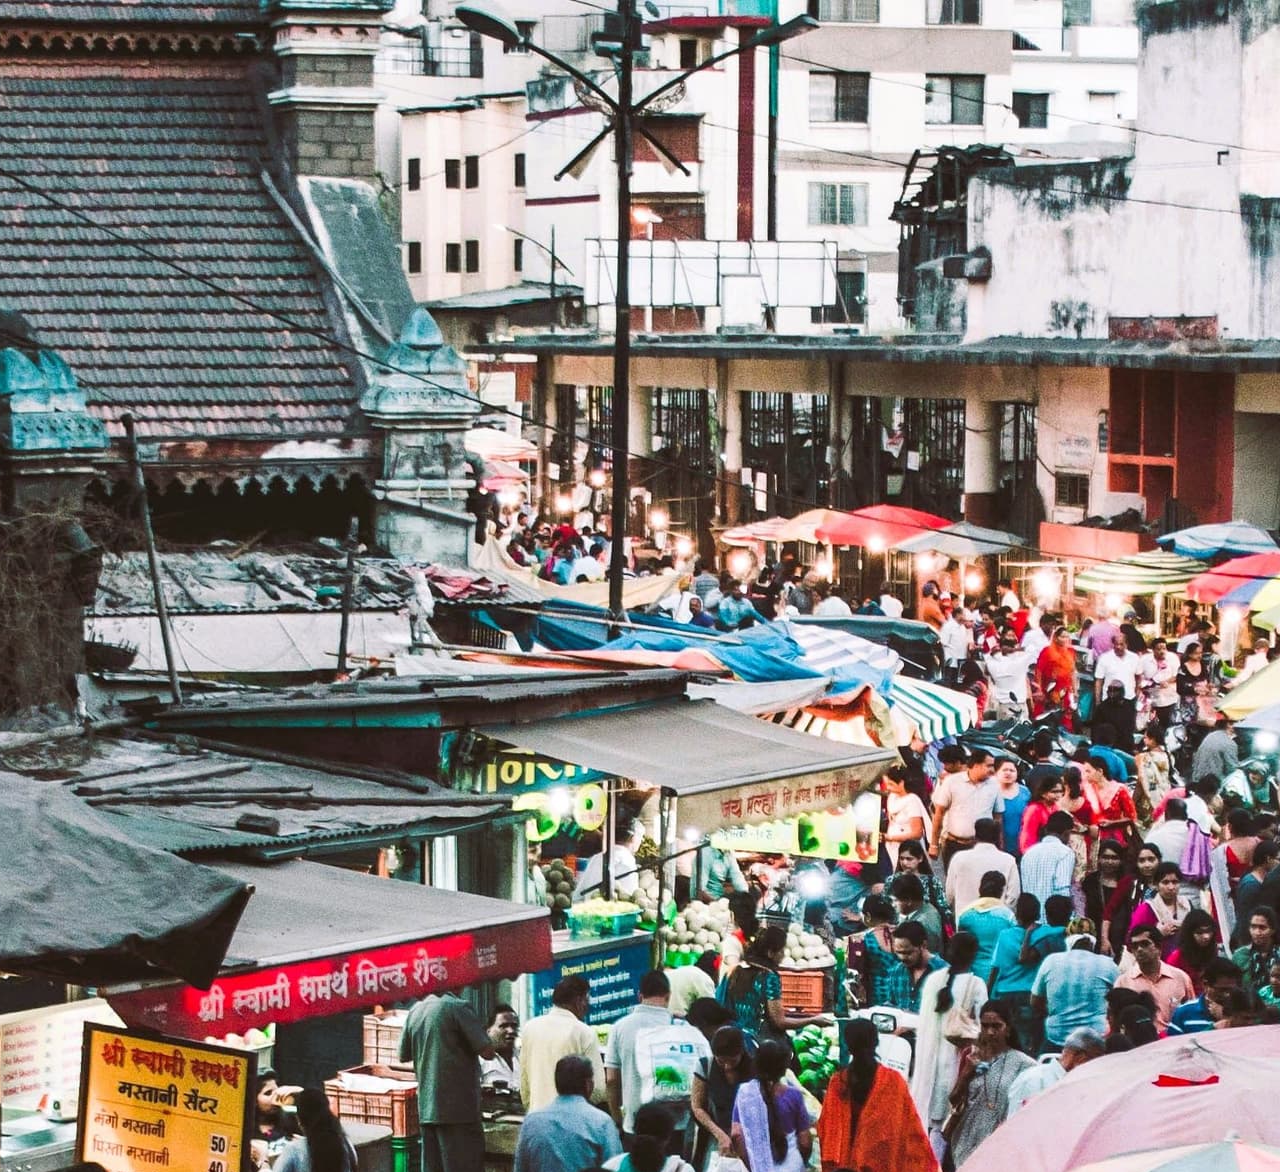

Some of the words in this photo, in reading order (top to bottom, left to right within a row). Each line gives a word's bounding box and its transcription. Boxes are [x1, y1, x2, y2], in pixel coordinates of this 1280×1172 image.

[198, 986, 224, 1022] श्री
[231, 973, 291, 1016] स्वामी
[298, 961, 350, 1005] समर्थ
[355, 958, 410, 997] मिल्क
[411, 947, 449, 985] शेक
[101, 1038, 127, 1068] श्री
[131, 1048, 187, 1079] स्वामी
[190, 1058, 242, 1089] समर्थ
[118, 1081, 179, 1108] मस्तानी
[183, 1087, 220, 1115] सेंटर
[122, 1118, 166, 1139] मस्तानी
[126, 1146, 170, 1167] मस्तानी
